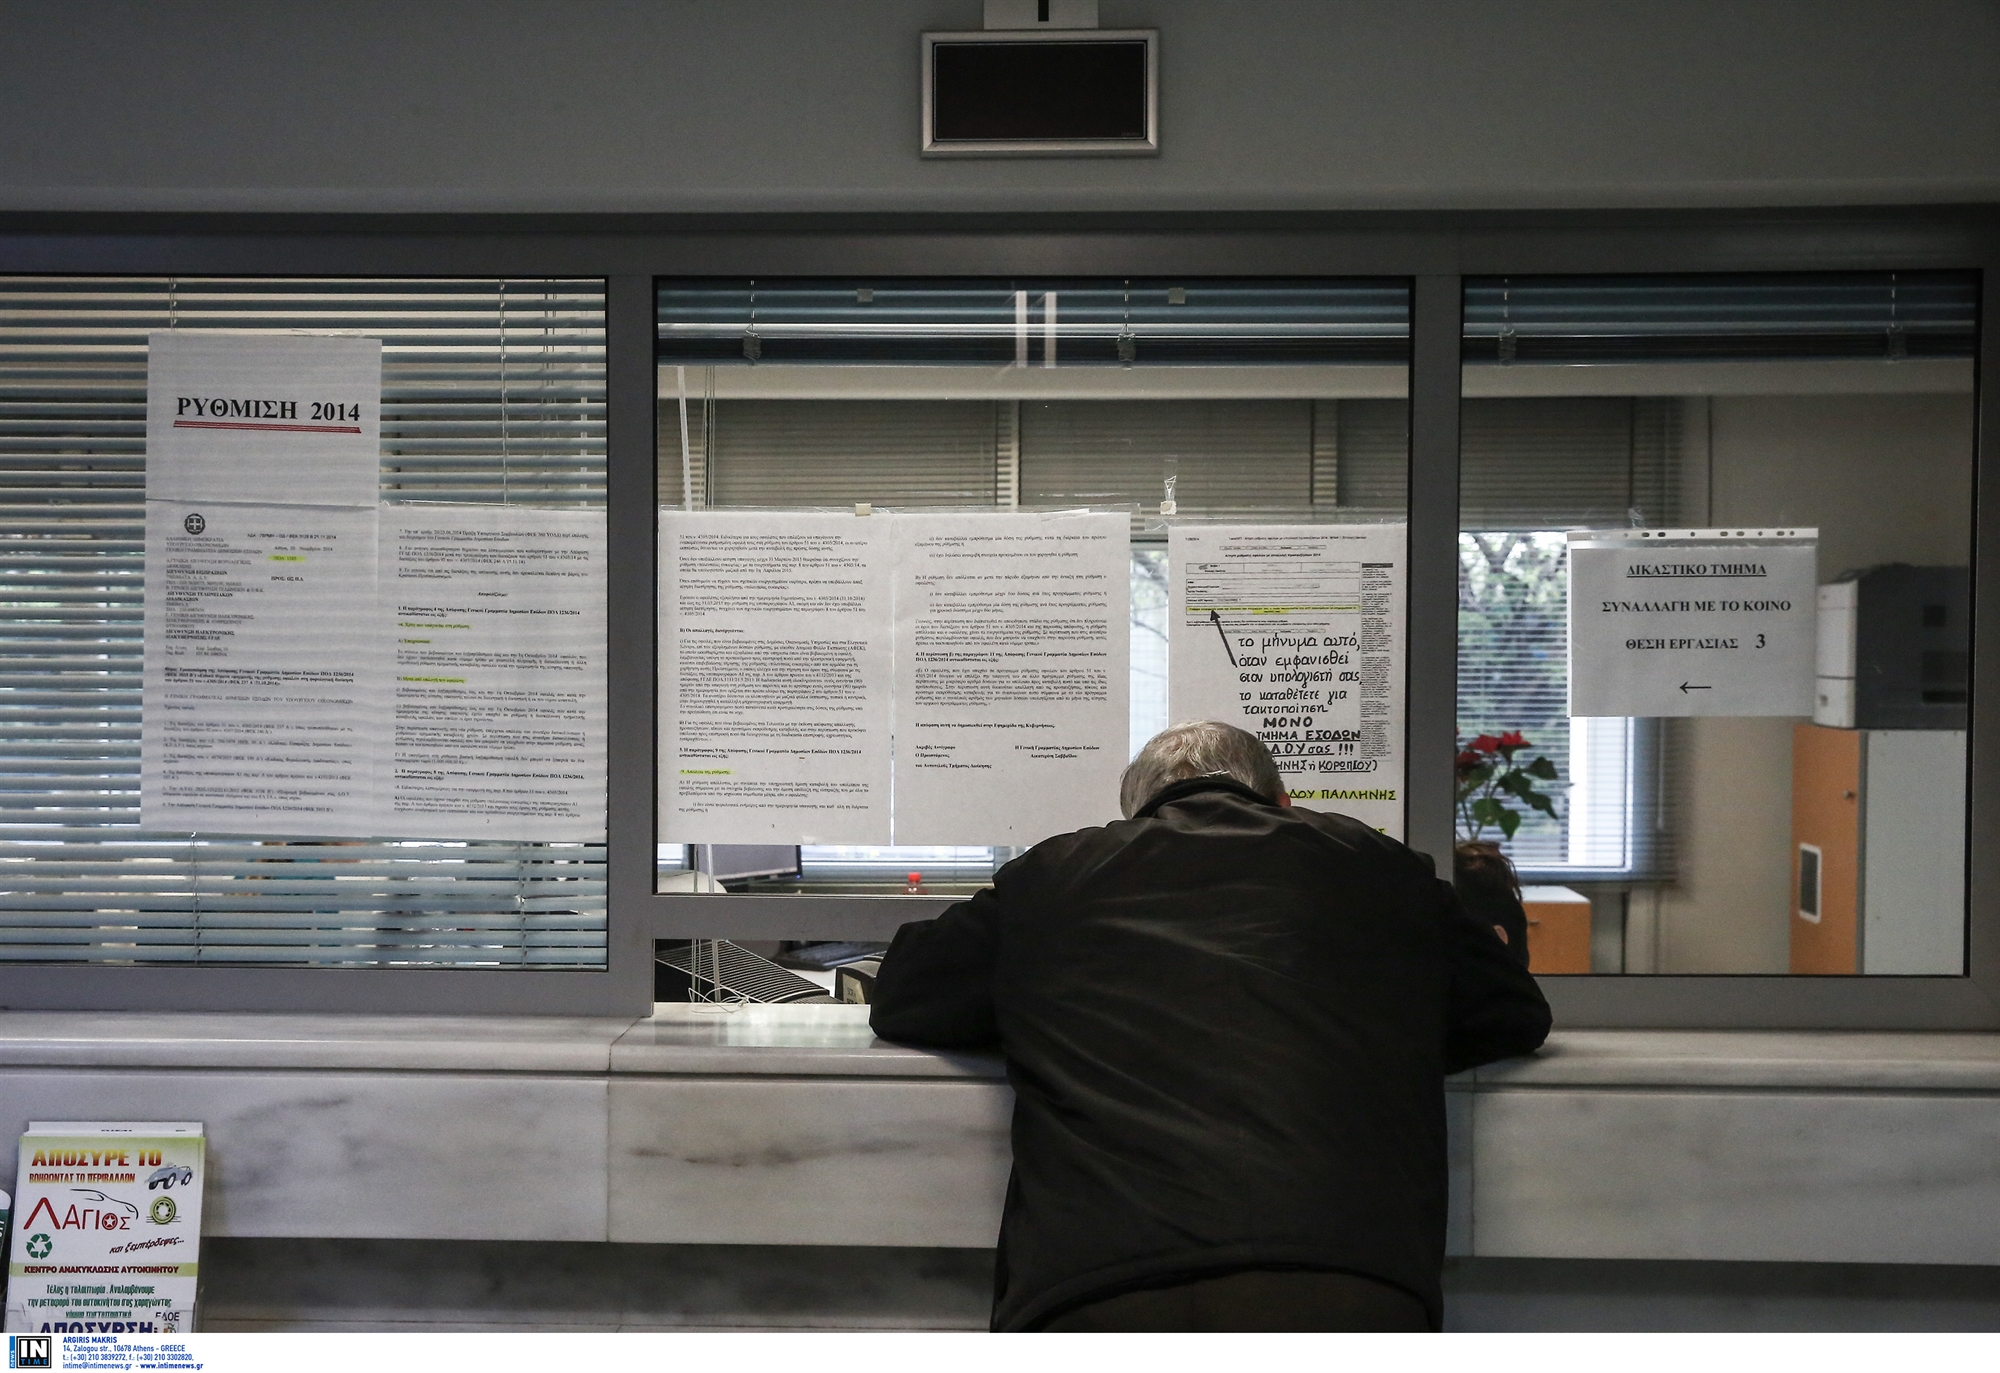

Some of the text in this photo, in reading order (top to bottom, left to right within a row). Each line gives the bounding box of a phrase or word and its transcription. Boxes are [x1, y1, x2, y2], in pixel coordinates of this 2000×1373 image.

[176, 397, 360, 421] ΡΥΘΜΙΣΗ 2014
[1626, 564, 1767, 576] ΔΙΚΑΣΤΙΚΟ ΤΜΗΜΑ
[1602, 600, 1791, 612] ΣΥΝΑΛΛΑΓΗ ΜΕ ΤΟ ΚΟΙΝΟ
[1238, 632, 1360, 654] το μήνυμα αυτό,
[1626, 634, 1766, 649] ΘΕΣΗ ΕΡΓΑΣΙΑΣ 3
[1239, 650, 1349, 671] όταν εμφανισθεί
[1239, 672, 1263, 682] στον
[1270, 668, 1332, 688] υπολογιστή
[1239, 688, 1347, 706] το καταθέτετε για
[1243, 703, 1328, 714] τακτοποίηση
[1263, 716, 1313, 728] ΜΟΝΟ
[1256, 730, 1361, 740] ΤΜΗΜΑ ΕΣΟΔΩΝ
[1308, 744, 1331, 754] σας
[1321, 789, 1397, 800] ΠΑΛΛΗΝΗΣ
[31, 1149, 162, 1166] ΑΠΟΣΥΡΕ ΤΟ
[76, 1173, 85, 1183] ΤΟ
[23, 1197, 131, 1230] ΛΑΓΙΟΣ
[109, 1246, 124, 1254] και
[24, 1265, 179, 1274] ΚΕΝΤΡΟ ΑΝΑΚΥΚΛΩΣΗΣ ΑΥΤΟΚΙΝΗΤΟΥ
